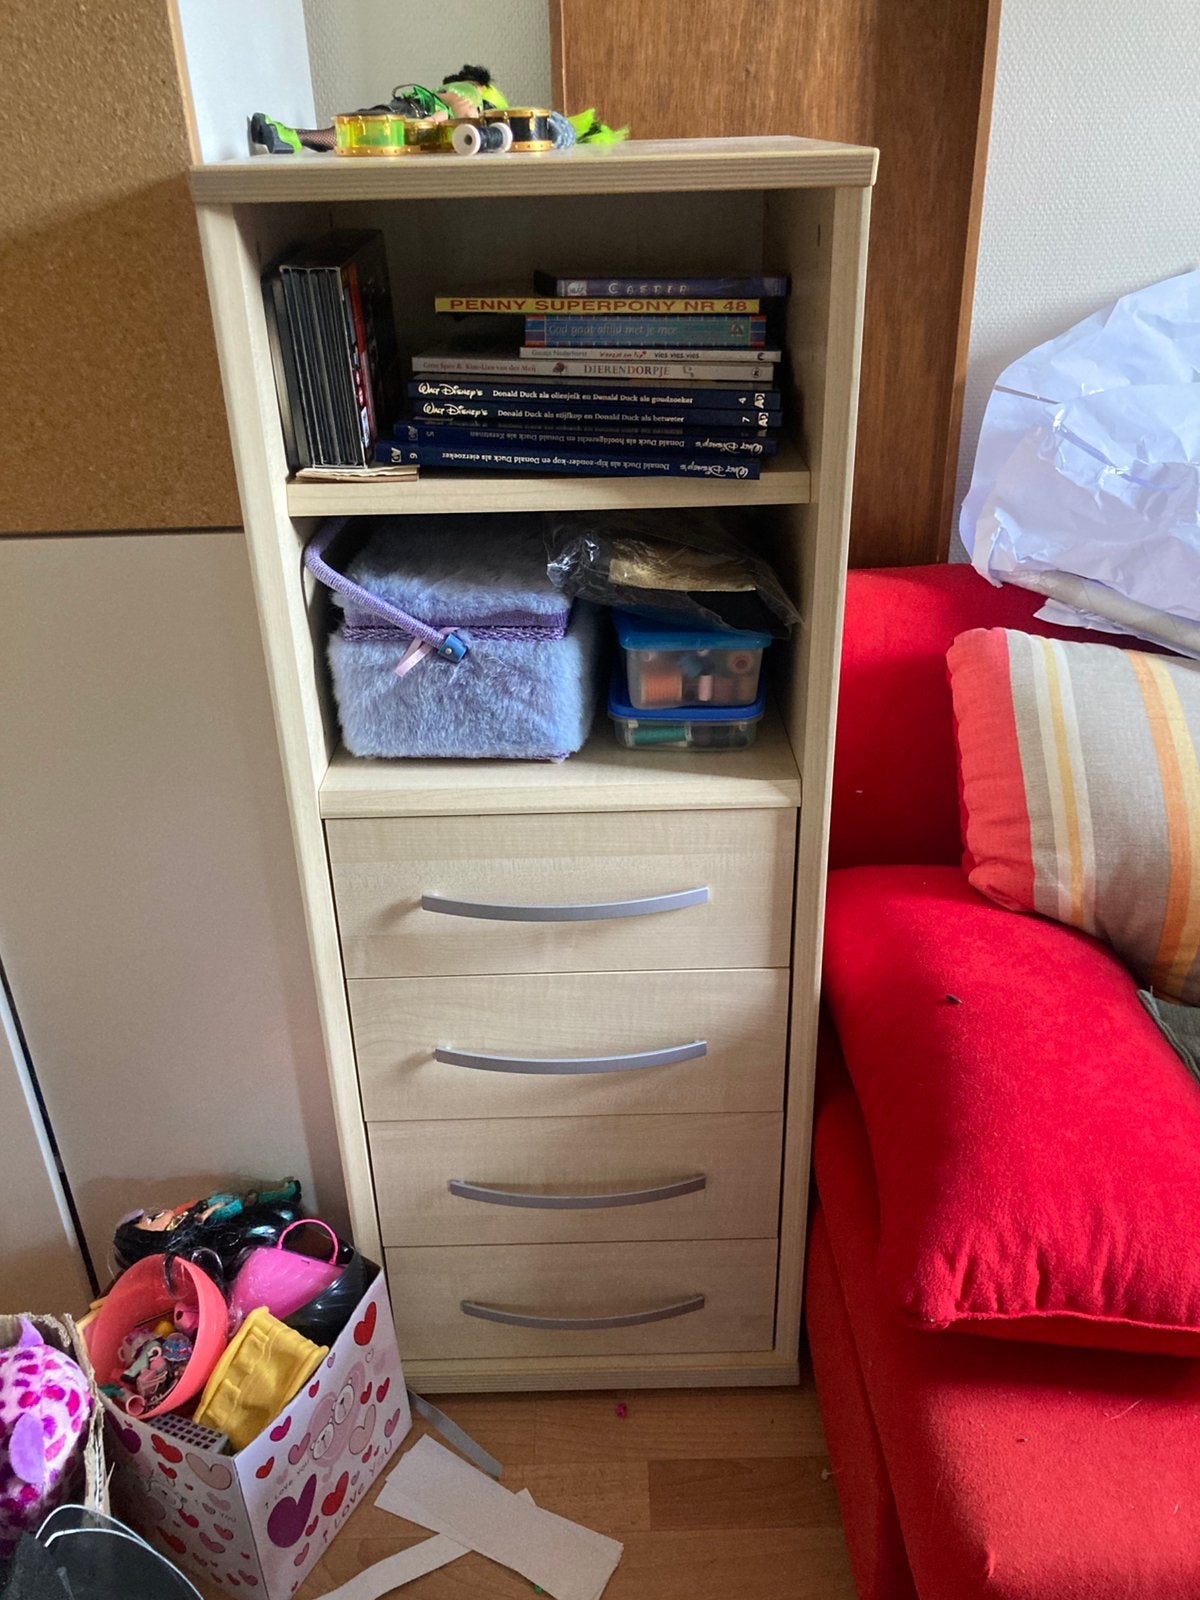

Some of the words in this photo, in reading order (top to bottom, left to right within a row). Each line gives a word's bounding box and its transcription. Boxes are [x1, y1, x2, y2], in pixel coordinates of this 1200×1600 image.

[450, 299, 526, 311] PENNY
[535, 299, 676, 312] SUPERPONY
[684, 300, 715, 312] NR
[723, 301, 747, 312] 48
[654, 351, 668, 359] vies
[686, 352, 700, 360] vies
[584, 364, 670, 377] DIERENDORPJE
[493, 389, 518, 399] Donald
[519, 390, 537, 399] Duck
[539, 391, 550, 399] als
[592, 392, 618, 402] Donald
[620, 394, 638, 402] Duck
[639, 394, 650, 402] als
[738, 396, 747, 405] 4
[498, 409, 523, 418] Donald
[524, 409, 542, 418] Duck
[544, 411, 554, 419] als
[594, 412, 620, 421] Donald
[621, 413, 640, 422] Duck
[641, 414, 652, 422] als
[653, 414, 685, 423] betweter
[518, 433, 537, 442] Duck
[538, 434, 565, 443] Donald
[626, 437, 637, 445] als
[638, 438, 657, 447] Duck
[658, 439, 685, 448] Donald
[481, 454, 492, 462] als
[493, 455, 512, 464] Duck
[513, 456, 540, 465] Donald
[610, 460, 621, 469] als
[623, 461, 642, 470] Duck
[643, 462, 670, 471] Donald
